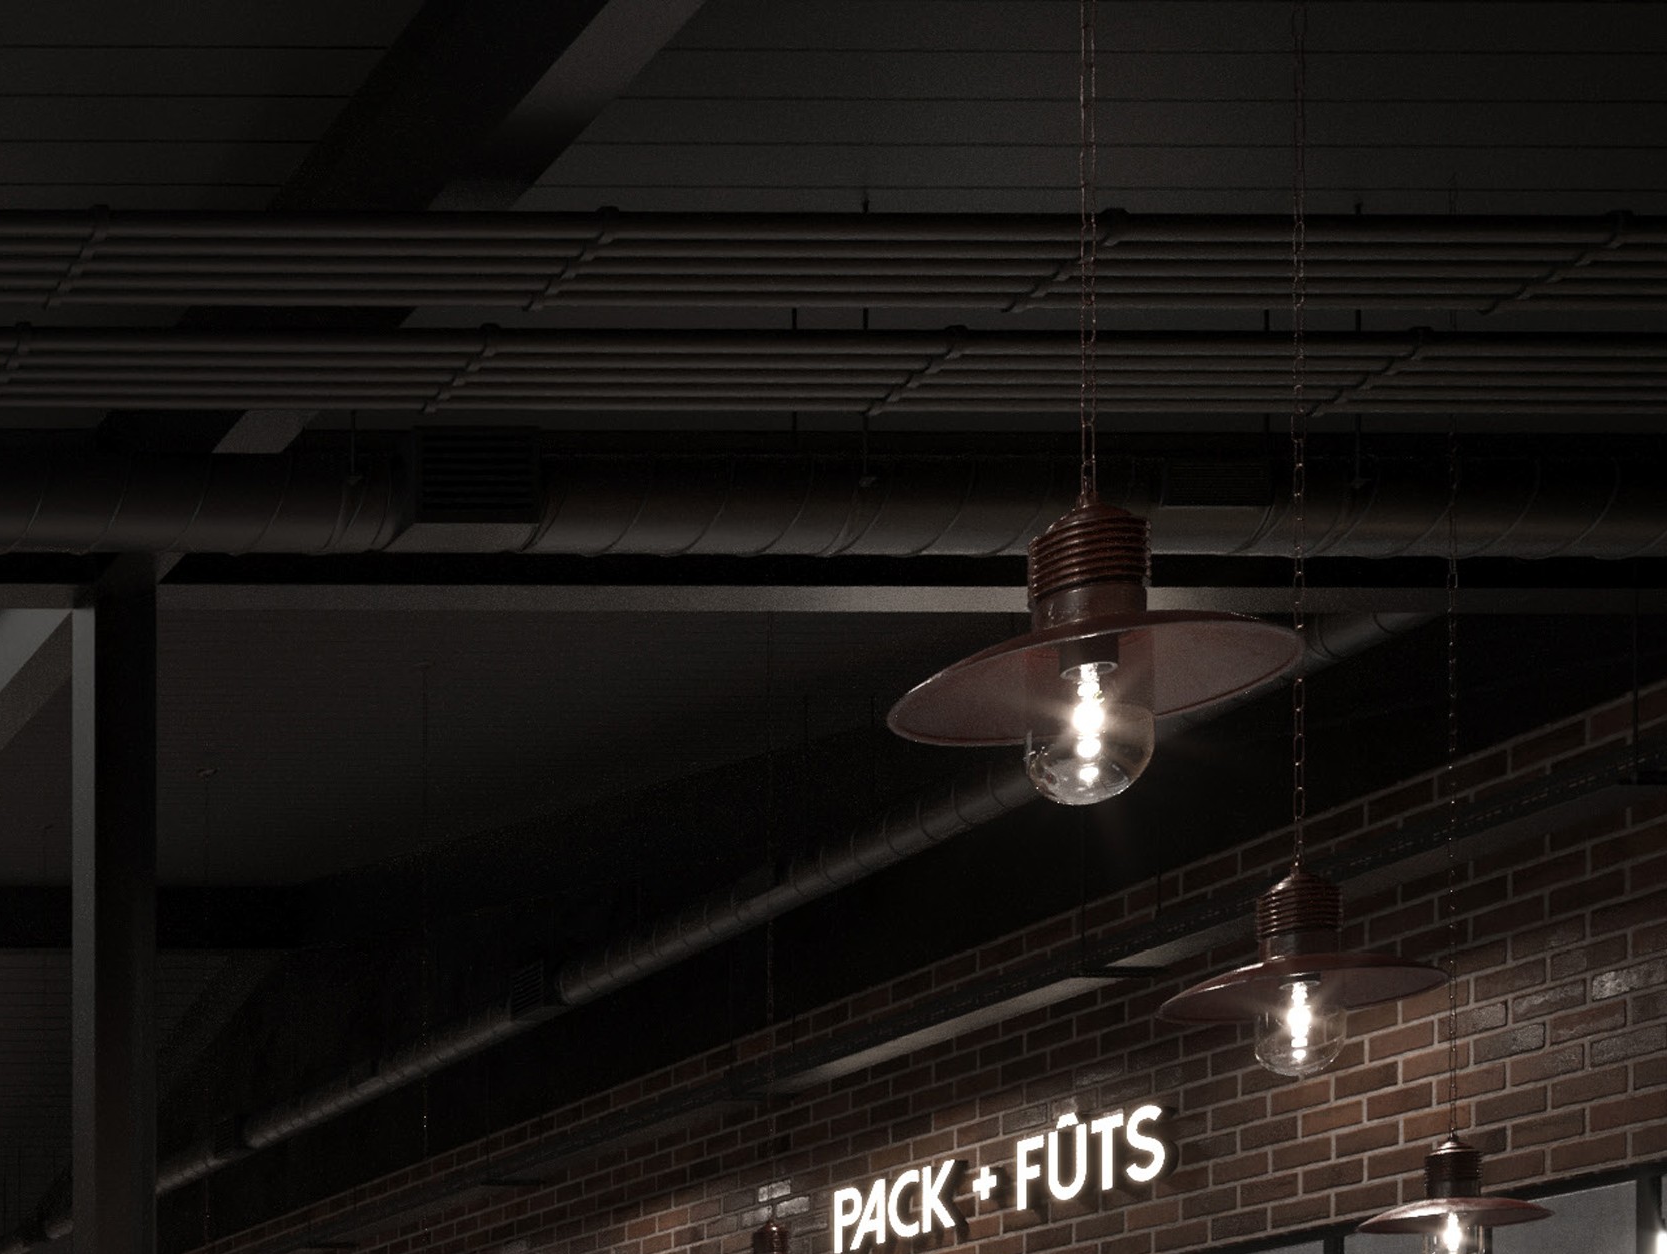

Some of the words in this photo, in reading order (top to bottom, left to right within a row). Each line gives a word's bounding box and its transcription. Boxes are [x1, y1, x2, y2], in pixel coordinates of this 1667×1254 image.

[833, 1159, 956, 1254] PACK
[972, 1166, 997, 1201] +
[1016, 1105, 1166, 1211] FÛTS
